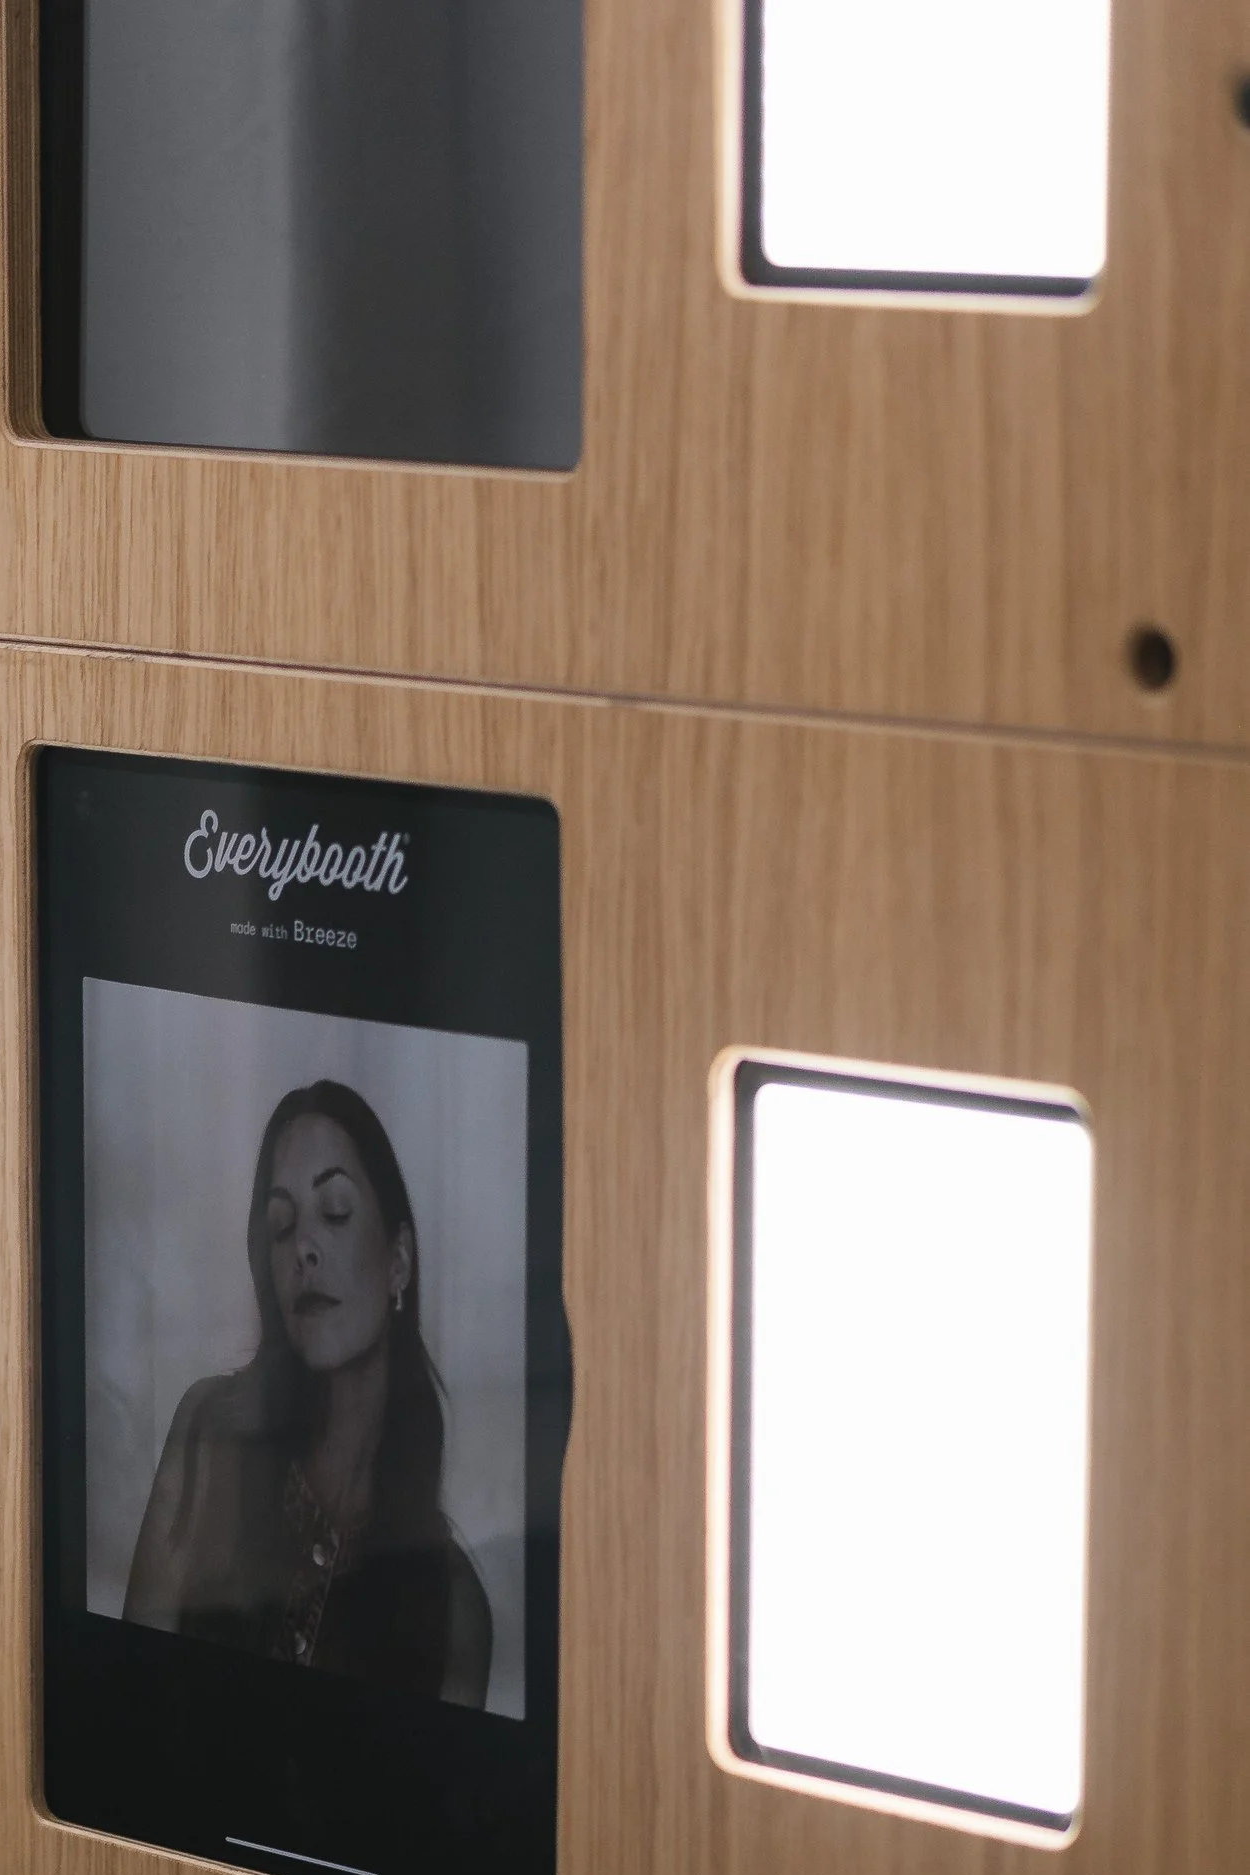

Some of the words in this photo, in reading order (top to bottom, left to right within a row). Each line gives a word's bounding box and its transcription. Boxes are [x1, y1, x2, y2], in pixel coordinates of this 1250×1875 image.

[184, 809, 408, 901] Everybooth
[230, 920, 256, 936] made
[261, 923, 288, 940] with
[293, 919, 358, 949] Breeze
